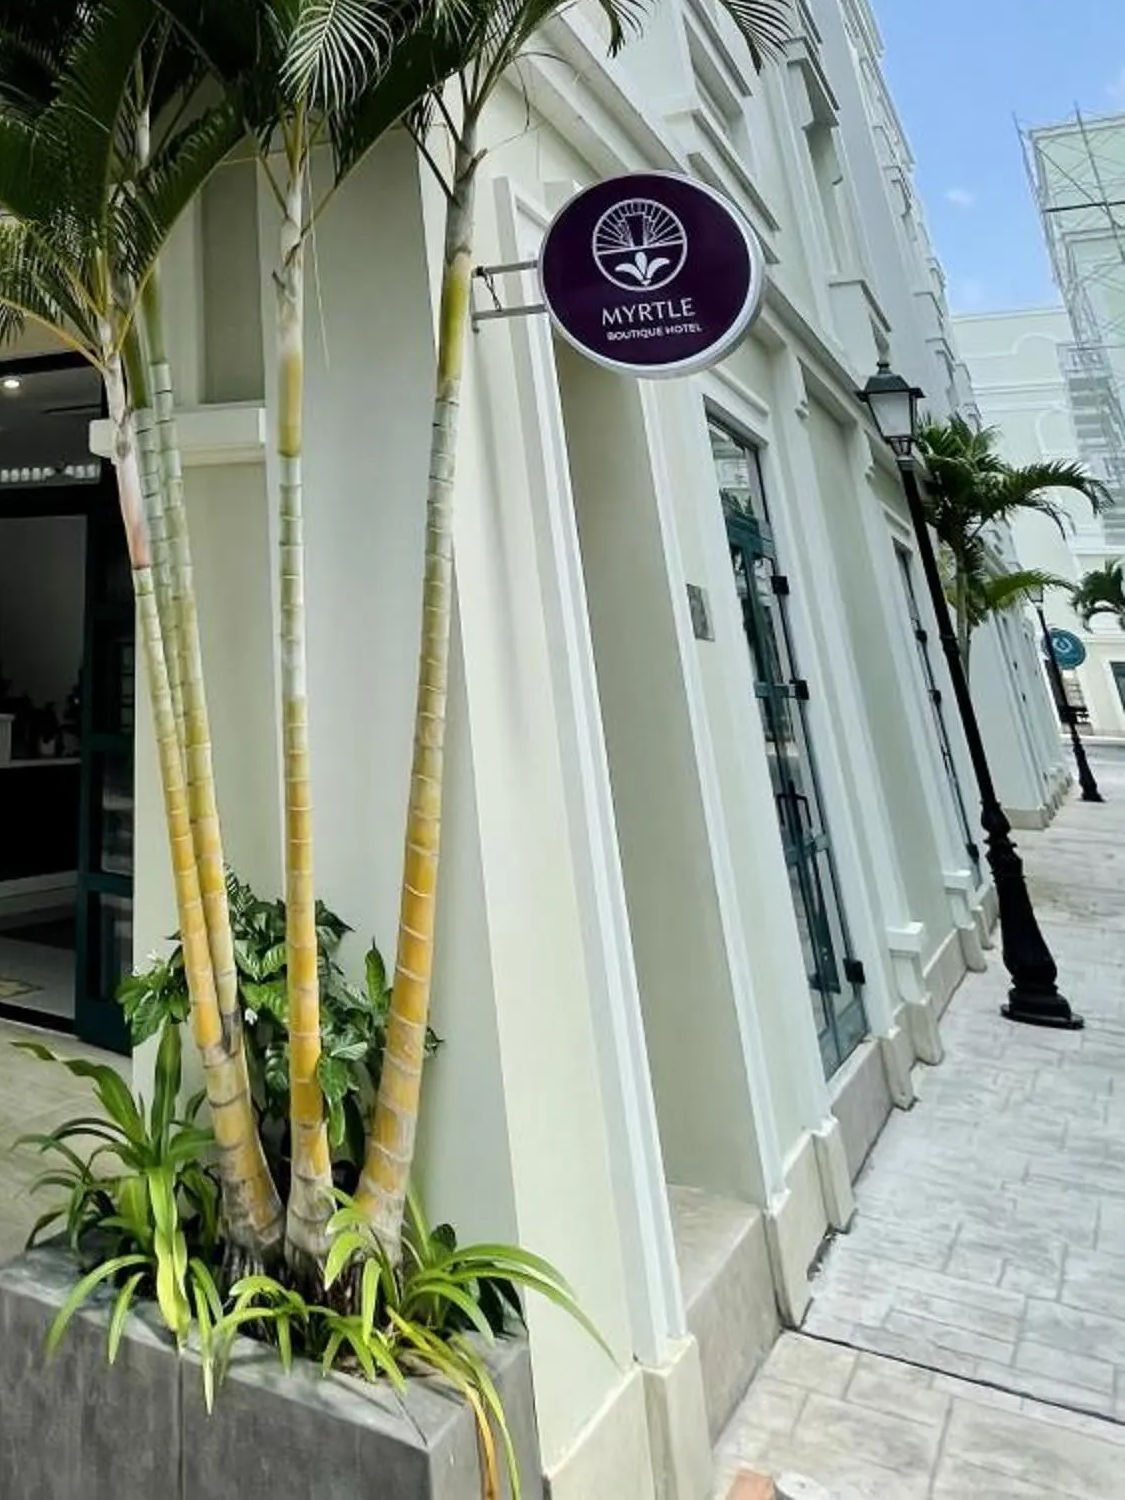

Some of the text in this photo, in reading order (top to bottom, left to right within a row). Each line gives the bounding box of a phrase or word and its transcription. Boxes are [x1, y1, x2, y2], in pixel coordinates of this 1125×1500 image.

[602, 297, 696, 326] MYRTLE
[606, 323, 703, 341] BOUTIQUE HOTEL
